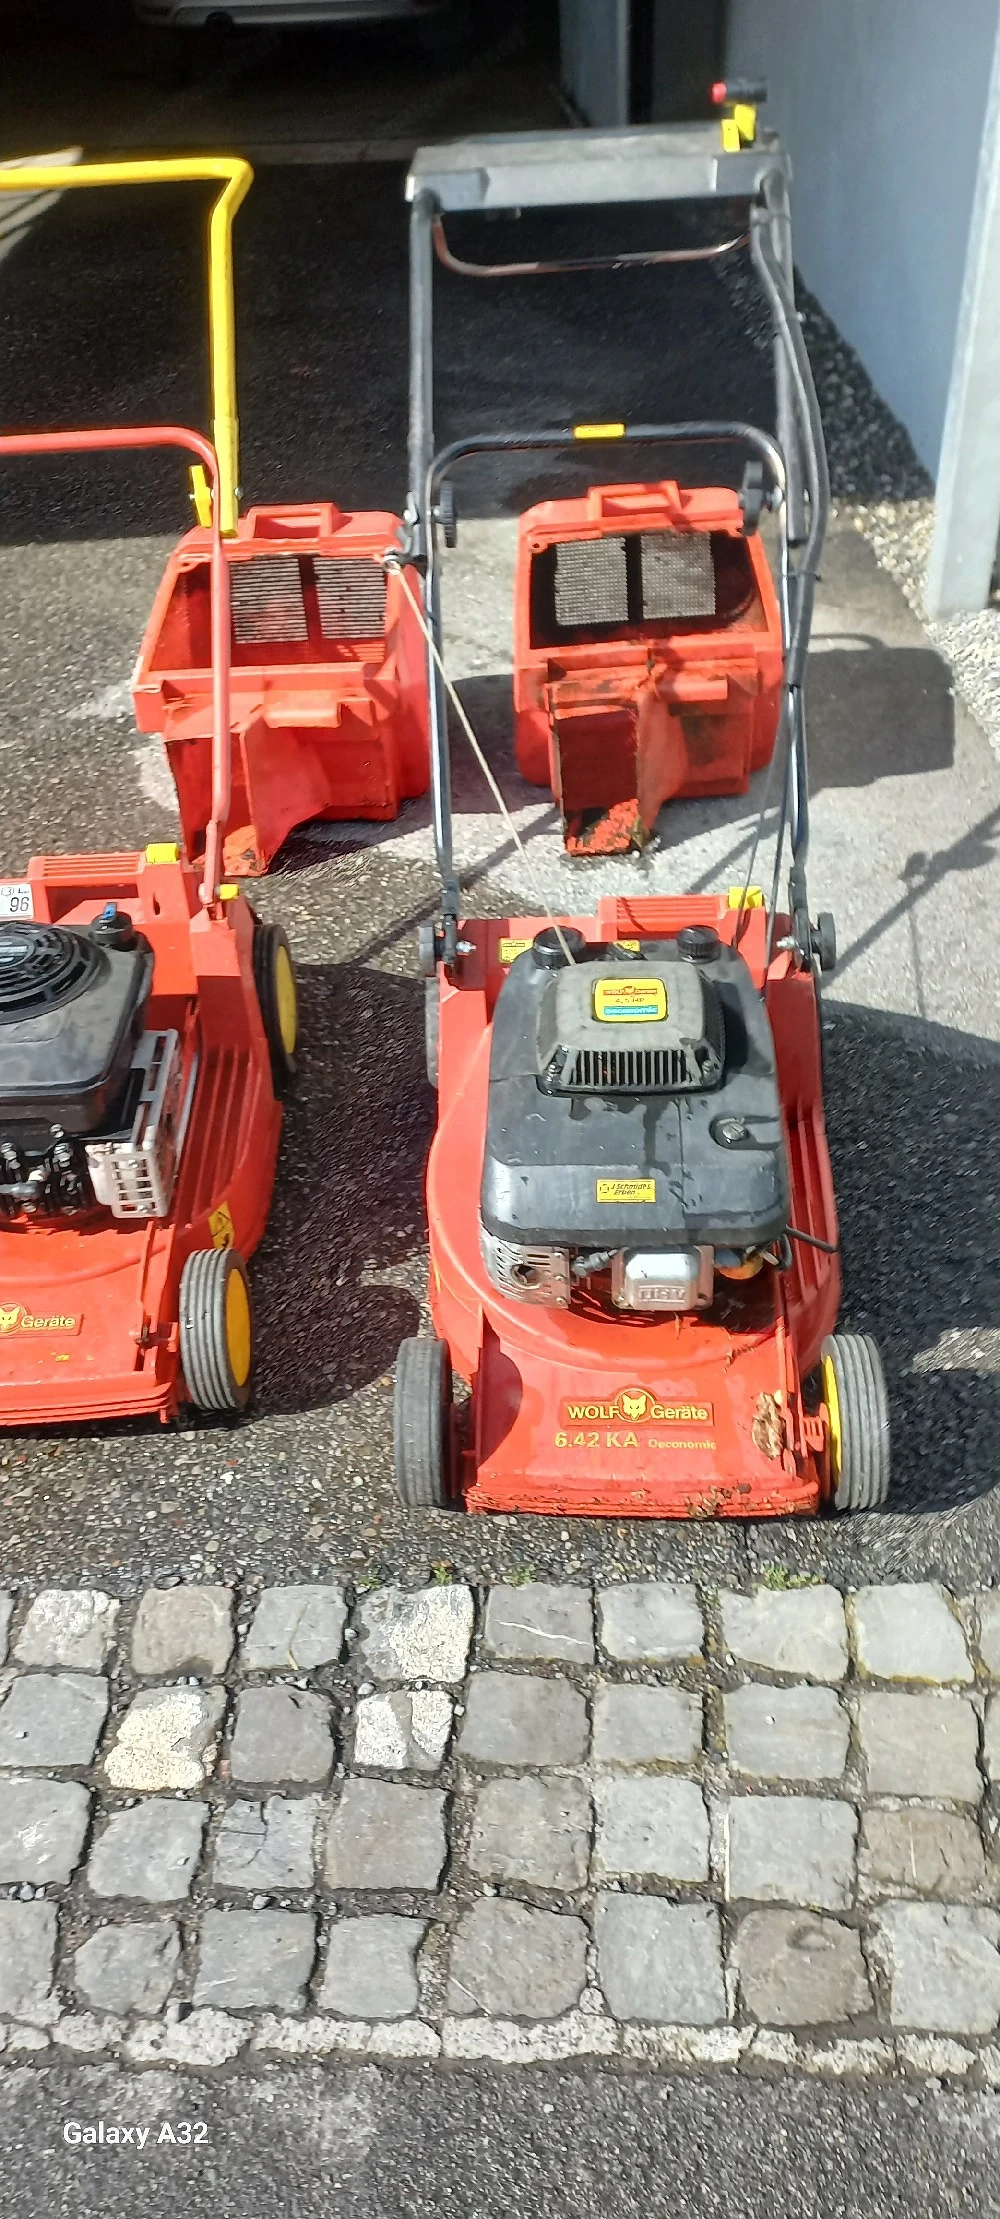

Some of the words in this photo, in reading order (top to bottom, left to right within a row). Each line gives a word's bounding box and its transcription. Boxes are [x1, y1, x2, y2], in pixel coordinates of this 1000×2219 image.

[10, 896, 30, 912] 96
[20, 1314, 76, 1330] Geräte
[567, 1405, 620, 1419] WOLF
[650, 1404, 709, 1421] Geräte
[554, 1431, 600, 1449] 6.42
[606, 1431, 639, 1449] KA
